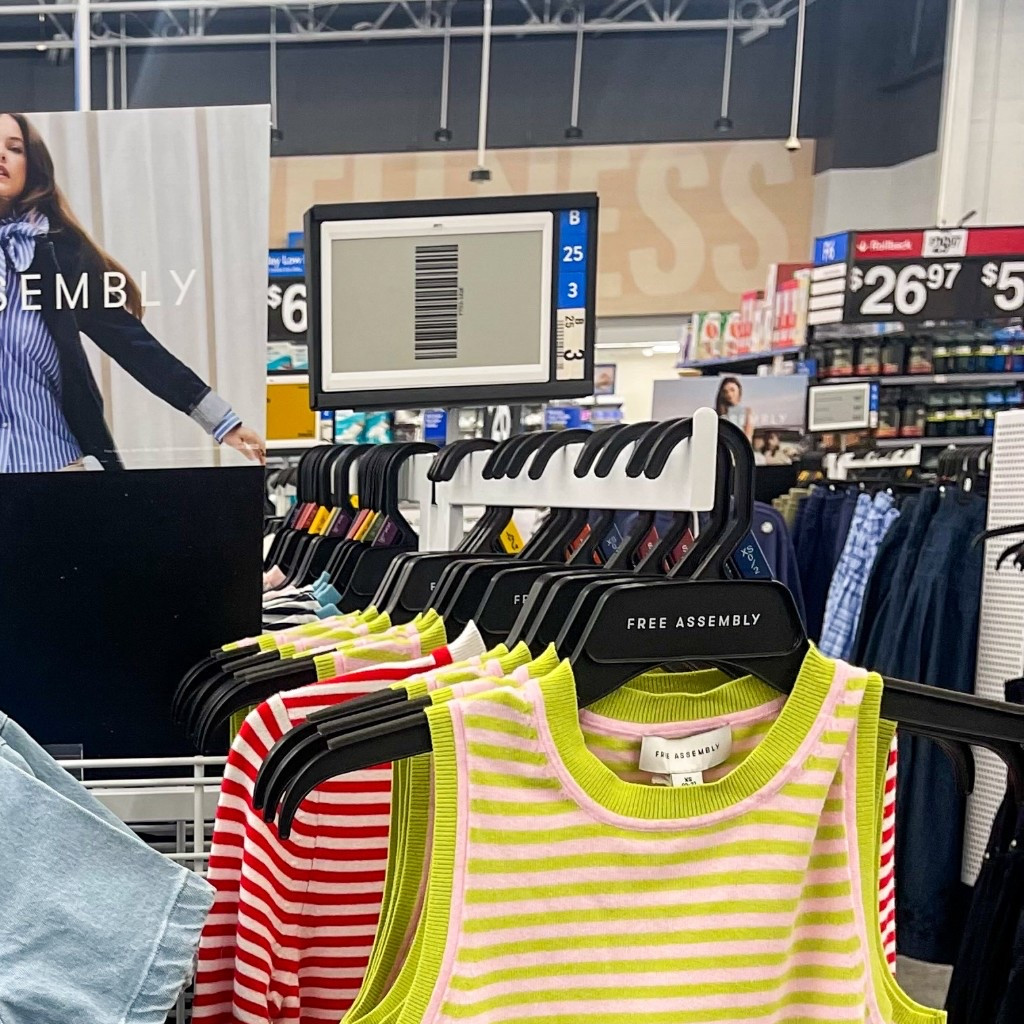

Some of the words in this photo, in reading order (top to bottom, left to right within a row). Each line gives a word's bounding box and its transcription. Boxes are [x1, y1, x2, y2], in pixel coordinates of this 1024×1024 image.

[568, 209, 581, 226] B
[562, 245, 585, 263] 25
[567, 282, 579, 299] 3
[563, 349, 585, 361] 3
[627, 617, 667, 630] FREE
[676, 613, 761, 628] ASSEMBLY
[674, 743, 720, 760] ASSEMBLY
